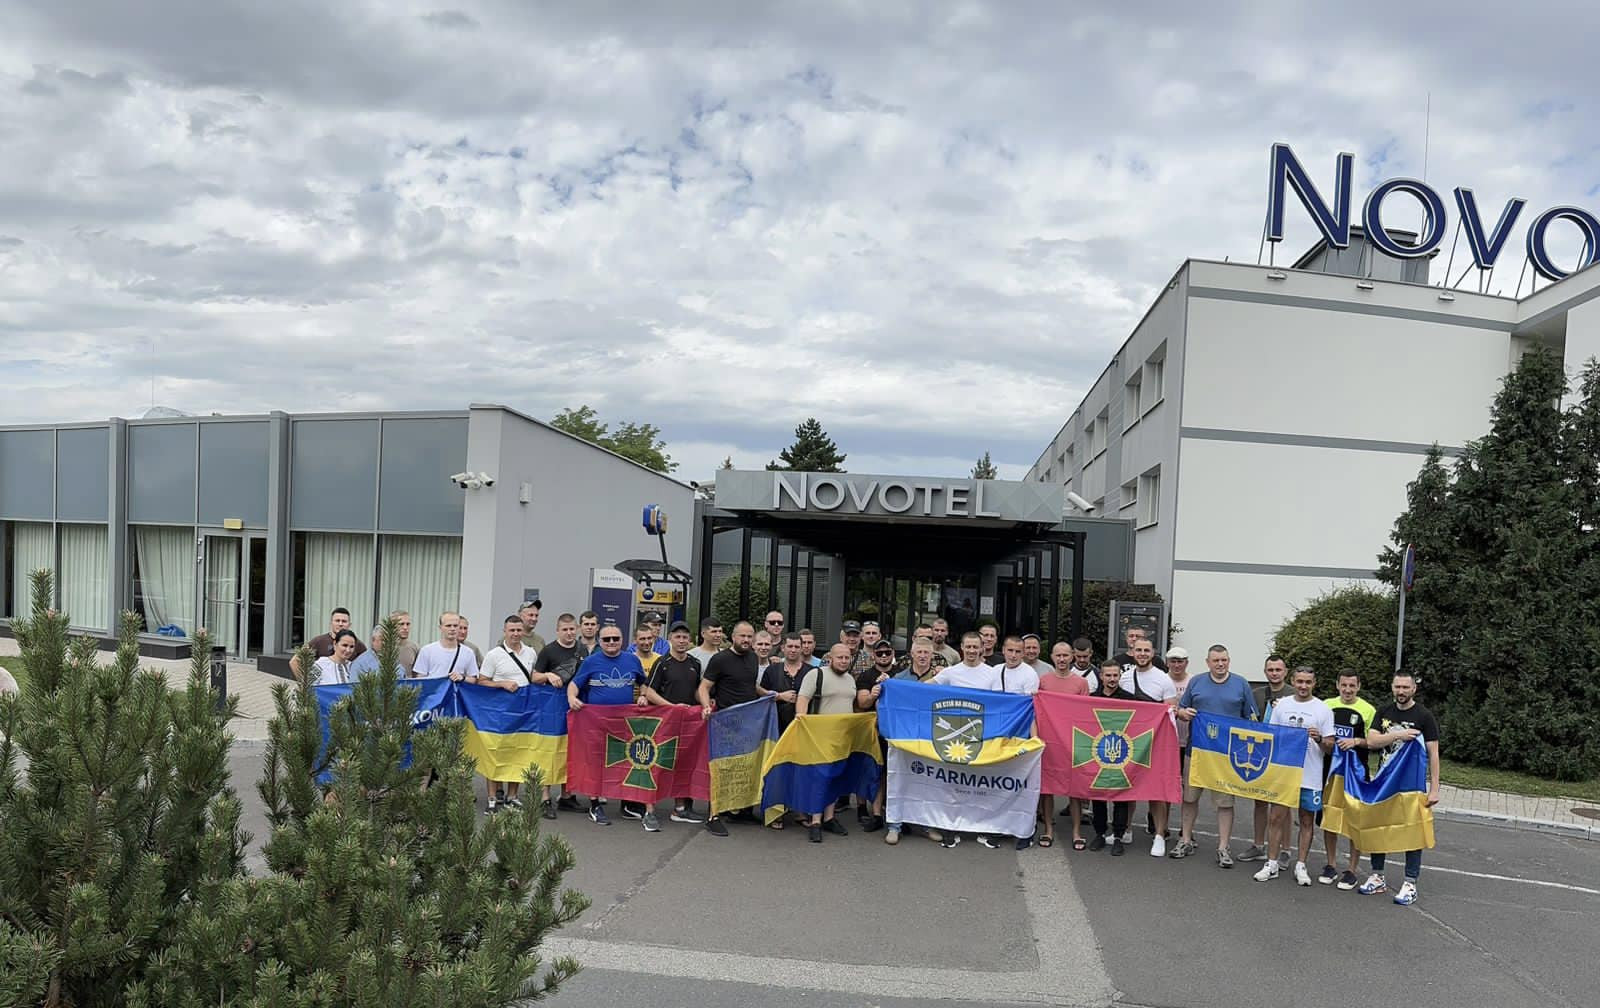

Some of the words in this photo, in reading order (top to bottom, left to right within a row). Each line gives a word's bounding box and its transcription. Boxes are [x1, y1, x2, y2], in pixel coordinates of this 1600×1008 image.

[773, 471, 1001, 518] NOVOTEL
[1335, 727, 1350, 737] GV
[926, 765, 1028, 792] FARMAKOM
